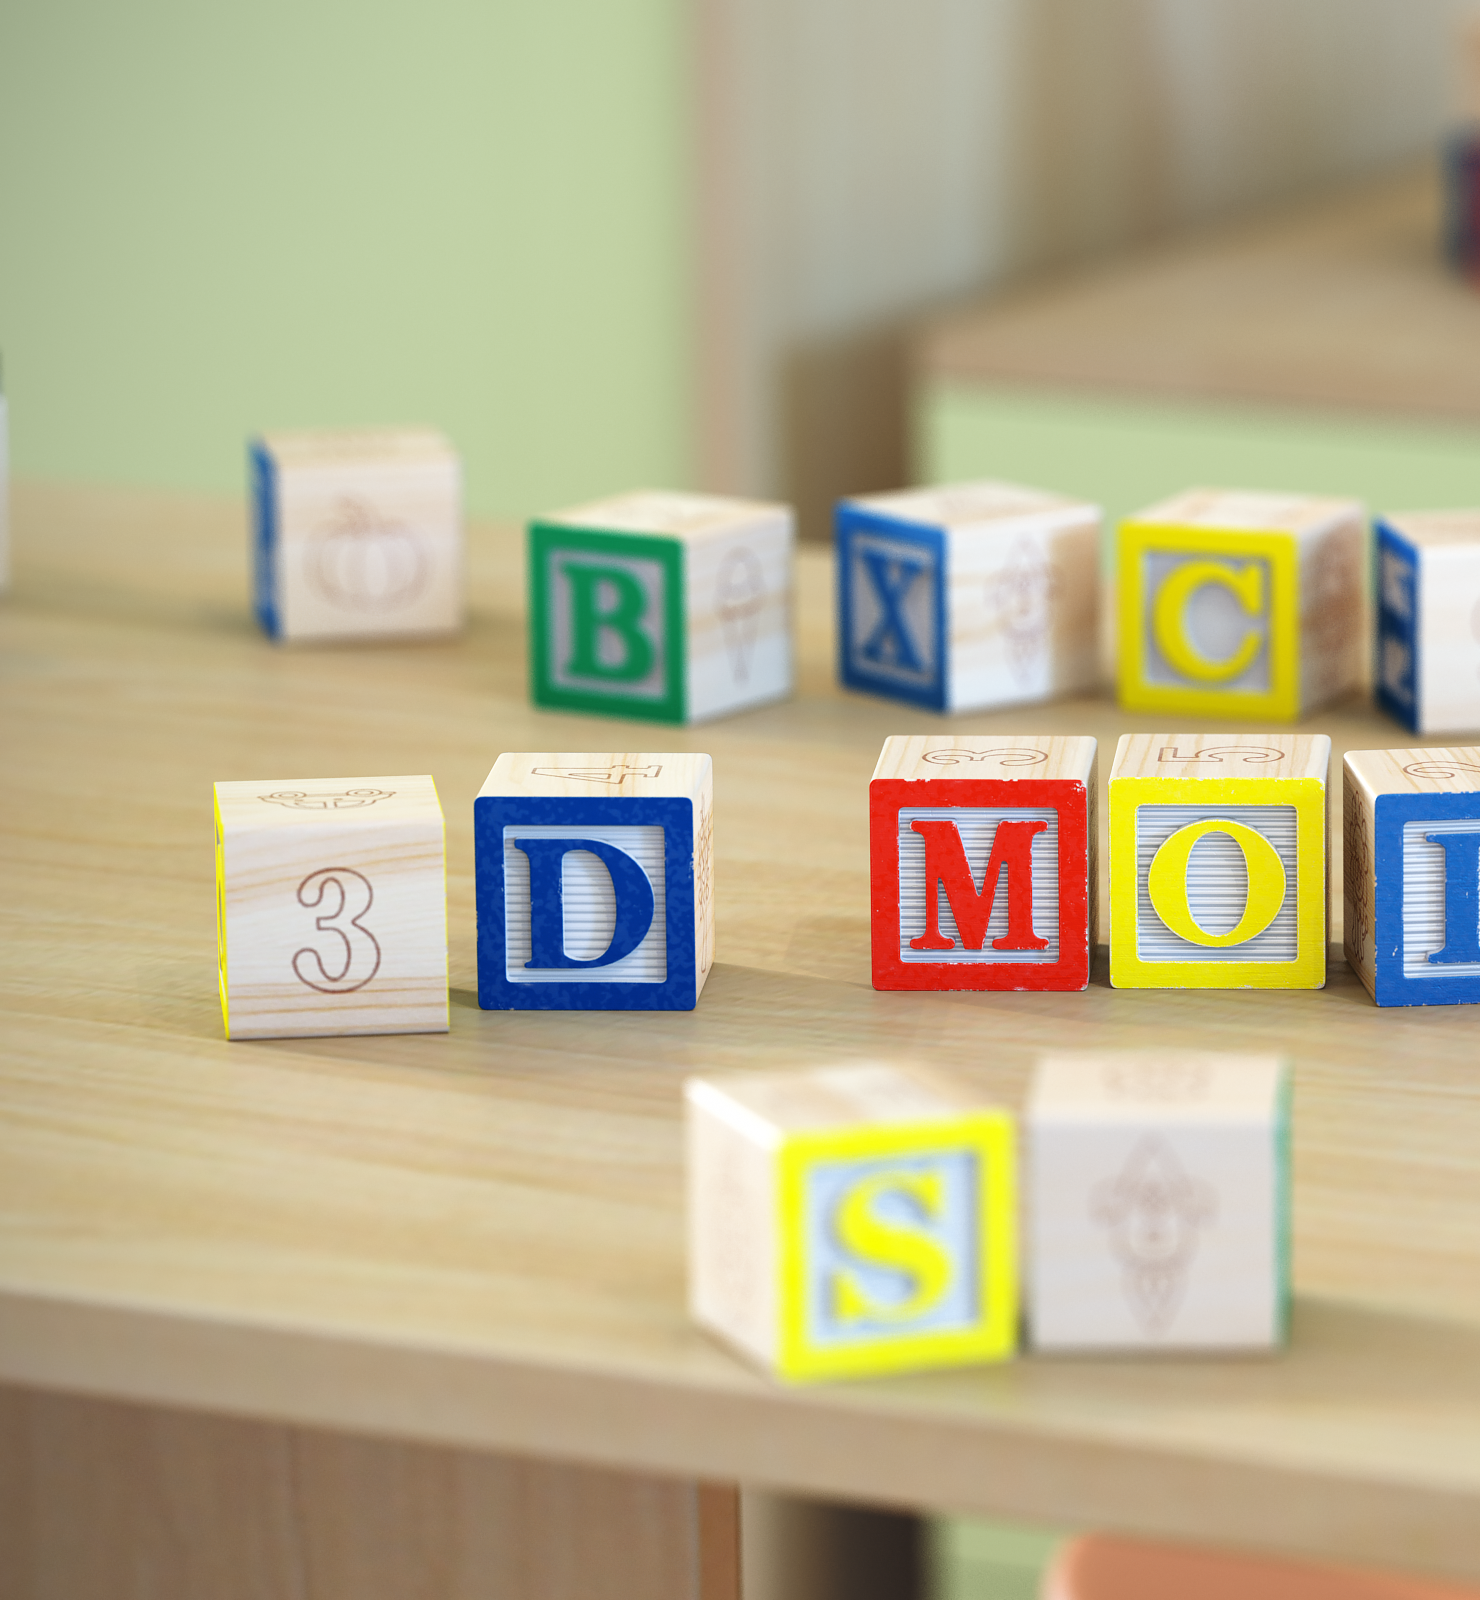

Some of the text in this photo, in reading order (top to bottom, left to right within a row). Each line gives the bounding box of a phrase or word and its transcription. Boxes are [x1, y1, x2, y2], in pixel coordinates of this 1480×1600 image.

[561, 562, 656, 682] B
[862, 551, 927, 675] X
[1152, 560, 1262, 683] C
[531, 765, 663, 784] 4
[921, 747, 1048, 766] 3
[1158, 745, 1285, 764] 5
[834, 1167, 952, 1322] S
